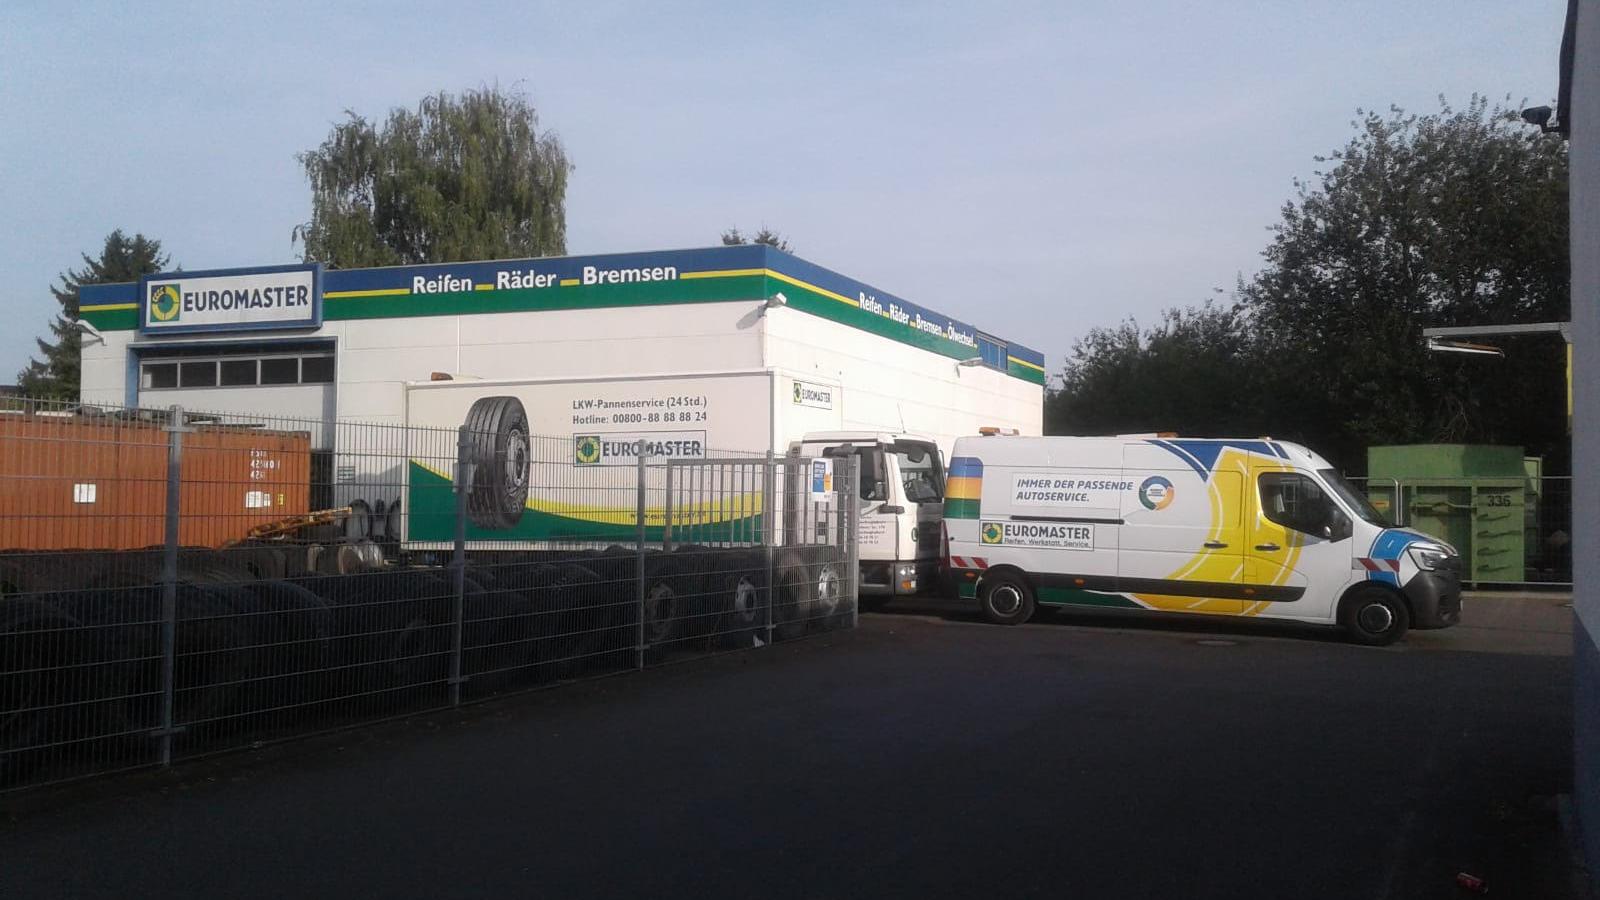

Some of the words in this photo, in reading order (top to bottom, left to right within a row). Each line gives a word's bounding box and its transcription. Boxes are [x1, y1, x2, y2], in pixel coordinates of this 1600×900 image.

[412, 274, 473, 295] Reifen
[497, 269, 557, 291] Räder
[583, 266, 677, 286] Bremsen
[183, 285, 309, 313] EUROMASTER
[859, 291, 883, 316] Reifen
[889, 303, 910, 326] Räder
[915, 313, 942, 336] Bremsen
[947, 322, 975, 347] Ölwechsel
[573, 398, 665, 410] LKW-Pannenservice
[684, 395, 707, 409] Std.)
[802, 388, 831, 403] EUROMASTER
[573, 414, 609, 425] Hotline:
[612, 412, 660, 424] 00800-88
[663, 411, 676, 422] 88
[679, 411, 692, 422] 88
[695, 411, 707, 422] 24
[1017, 478, 1051, 489] IMMER
[1054, 479, 1074, 489] DER
[1077, 480, 1134, 491] PASSENDE
[1016, 491, 1090, 502] AUTOSERVICE.
[1487, 494, 1511, 507] 336
[1004, 524, 1091, 540] EUROMASTER
[1004, 537, 1026, 545] Reifen.
[1064, 540, 1091, 549] Service.
